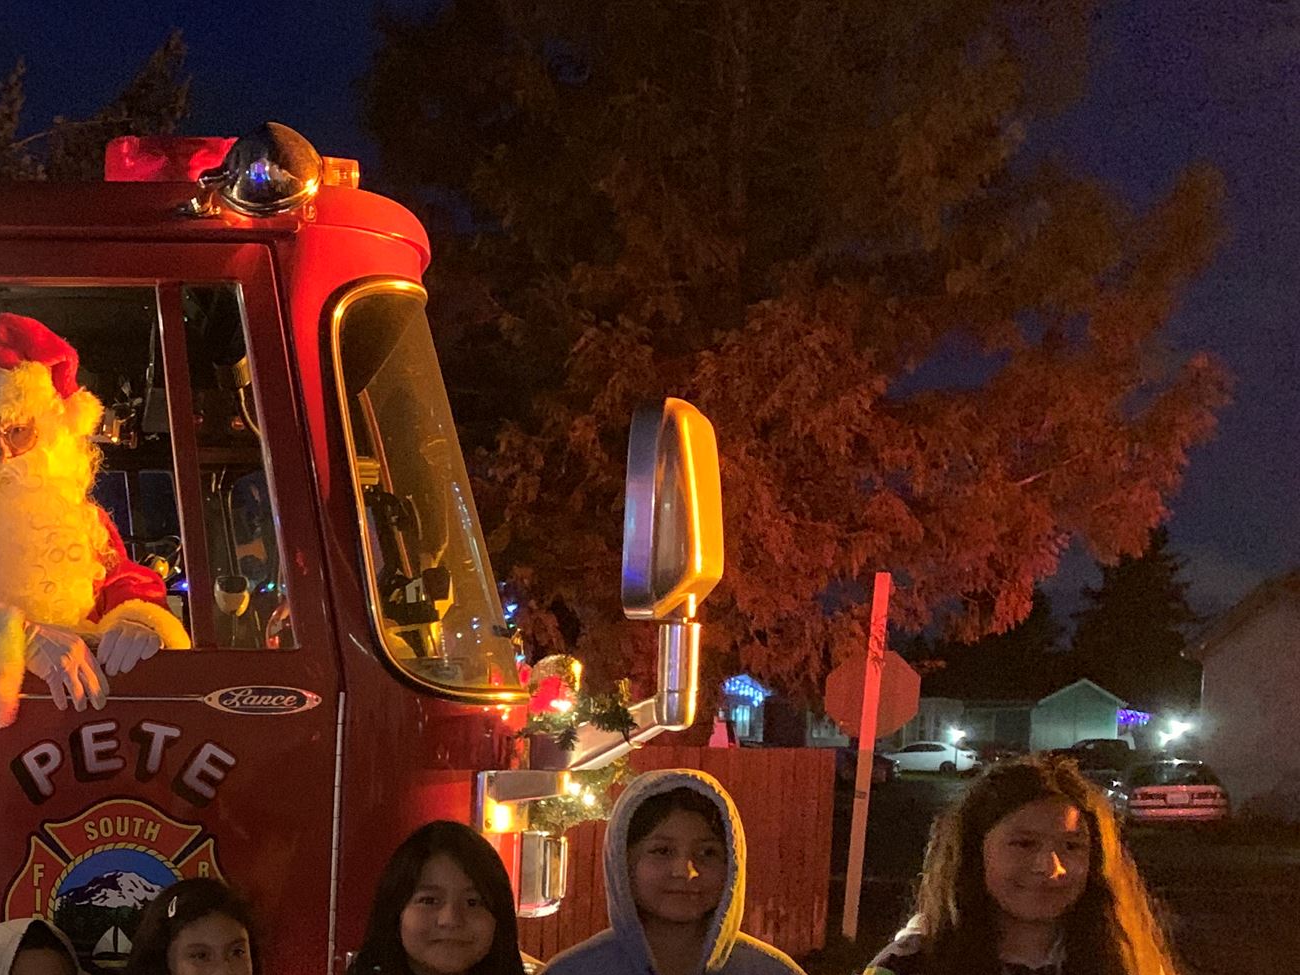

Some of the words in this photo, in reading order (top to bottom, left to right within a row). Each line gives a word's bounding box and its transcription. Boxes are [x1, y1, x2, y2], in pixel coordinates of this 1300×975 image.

[222, 688, 298, 709] Lance
[12, 719, 239, 805] PETE
[84, 816, 161, 842] SOUTH
